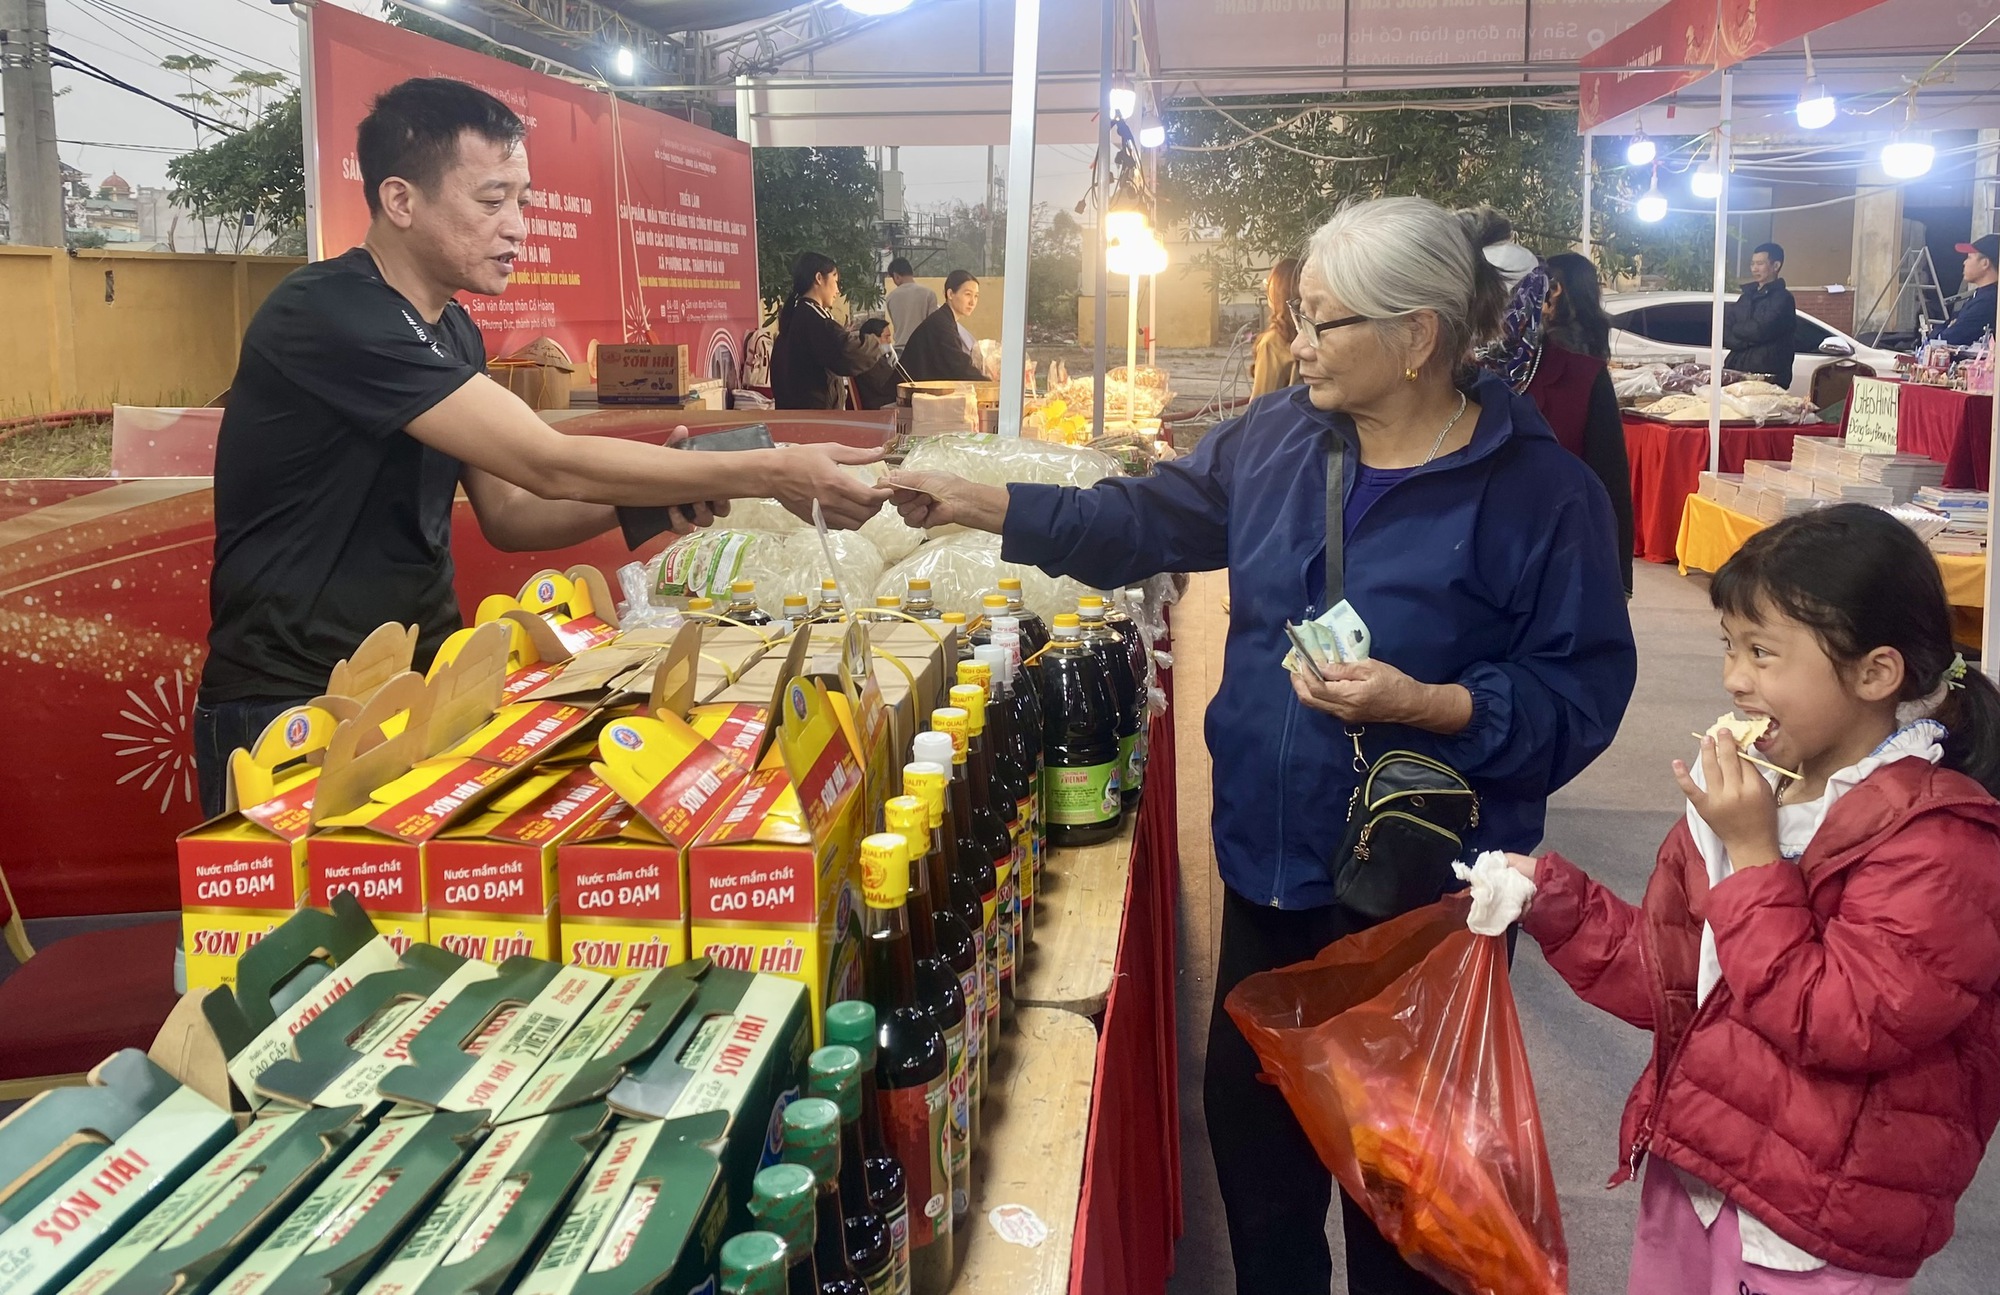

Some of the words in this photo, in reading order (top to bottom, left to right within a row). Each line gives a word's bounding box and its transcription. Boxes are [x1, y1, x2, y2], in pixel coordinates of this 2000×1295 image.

[530, 188, 547, 212] NGHỆ
[563, 192, 580, 213] SÁNG
[581, 196, 592, 217] TẠO
[562, 222, 577, 239] 2026
[529, 243, 538, 263] HÀ
[539, 244, 551, 266] NỘI
[472, 298, 485, 311] Sân
[486, 300, 499, 314] vận
[499, 299, 513, 314] động
[515, 298, 528, 311] thôn
[622, 354, 649, 368] SƠN
[652, 352, 675, 368] HẢI
[517, 729, 548, 747] SƠN
[535, 717, 563, 733] HẢI
[820, 777, 838, 812] SƠN
[831, 760, 847, 794] HẢI
[399, 824, 419, 837] CAO
[424, 795, 464, 818] SƠN
[449, 779, 485, 800] HẢI
[542, 799, 581, 821] SƠN
[566, 784, 601, 802] HẢI
[662, 820, 676, 834] CAO
[678, 785, 709, 816] SƠN
[696, 768, 722, 798] HẢI
[196, 864, 221, 876] Nước
[223, 859, 248, 873] mắm
[250, 856, 274, 870] chất
[325, 867, 350, 879] Nước
[352, 861, 377, 875] mắm
[378, 860, 401, 873] chất
[444, 868, 470, 880] Nước
[472, 863, 497, 877] mắm
[499, 861, 523, 874] chất
[577, 873, 604, 886] Nước
[606, 868, 633, 883] mắm
[635, 865, 659, 879] chất
[709, 876, 737, 889] Nước
[740, 870, 767, 885] mắm
[769, 867, 794, 880] chất
[197, 881, 231, 899] CAO
[235, 873, 275, 897] ĐẠM
[363, 877, 403, 900] ĐẠM
[445, 885, 479, 904] CAO
[484, 879, 524, 902] ĐẠM
[578, 890, 614, 909] CAO
[618, 883, 660, 907] ĐẠM
[710, 893, 747, 912] CAO
[752, 886, 795, 910] ĐẠM
[192, 928, 240, 957] SƠN
[492, 931, 534, 963] HẢI
[571, 940, 622, 968] SƠN
[625, 935, 670, 969] HẢI
[759, 939, 804, 974] HẢI
[711, 1042, 752, 1077] SƠN
[733, 1013, 769, 1044] HẢI
[466, 1080, 499, 1108] SƠN
[493, 1060, 518, 1082] HẢI
[369, 1127, 405, 1153] SƠN
[486, 1130, 521, 1159] SƠN
[608, 1136, 638, 1165] SƠN
[341, 1155, 376, 1180] HẢI
[464, 1161, 497, 1187] HẢI
[591, 1167, 621, 1195] HẢI
[31, 1188, 103, 1247] SƠN
[90, 1147, 151, 1197] HẢI
[930, 1197, 941, 1209] 20
